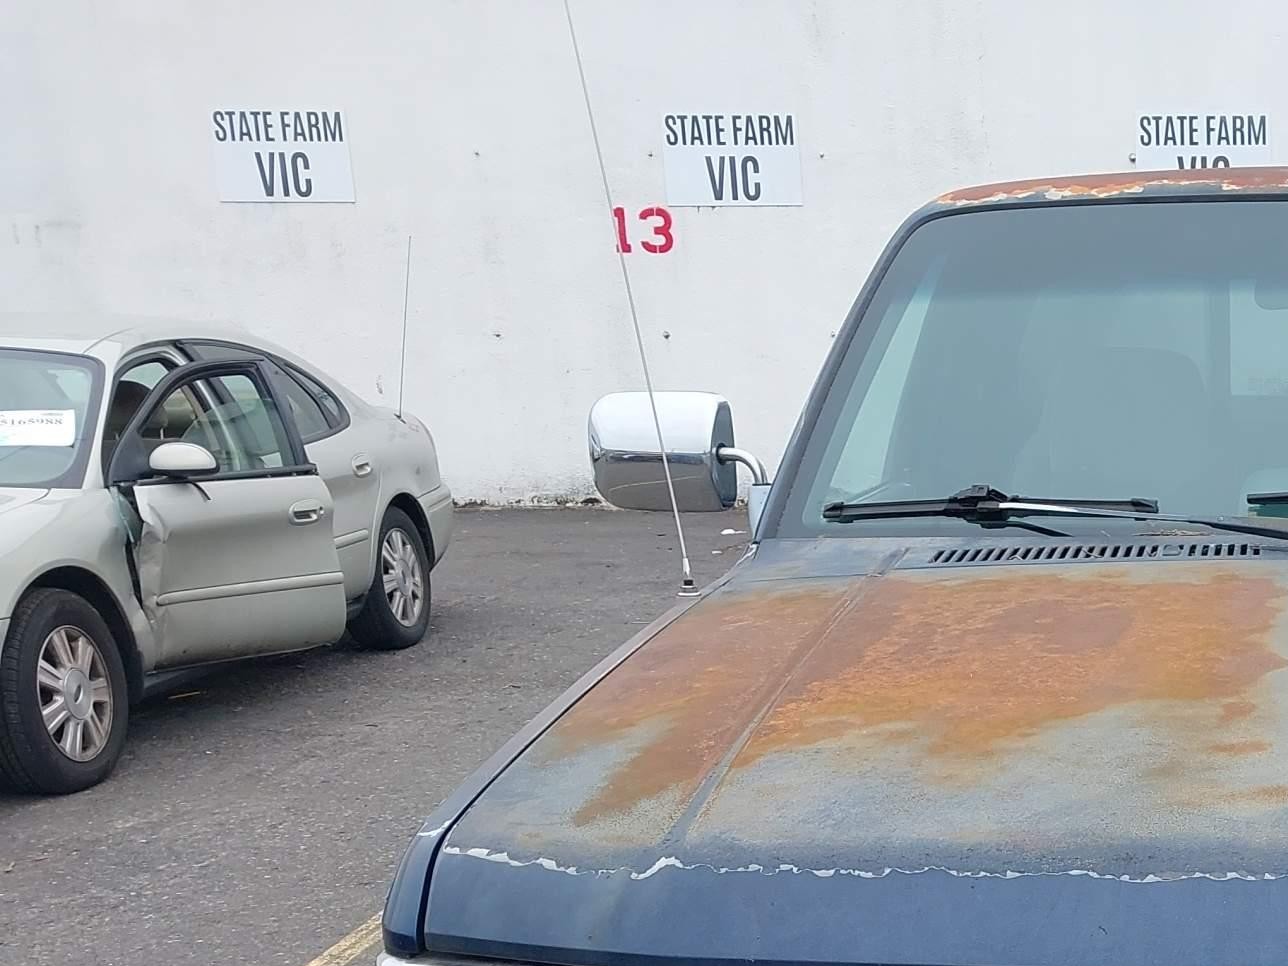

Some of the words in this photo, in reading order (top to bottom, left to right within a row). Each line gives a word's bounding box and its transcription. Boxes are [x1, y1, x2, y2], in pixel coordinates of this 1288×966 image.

[213, 111, 275, 142] STATE
[280, 111, 343, 142] FARM
[664, 115, 726, 146] STATE
[732, 115, 794, 146] FARM
[1139, 115, 1199, 147] STATE
[1206, 115, 1267, 146] FARM
[254, 151, 313, 198] VIC
[704, 155, 761, 202] VIC
[613, 206, 674, 254] 13
